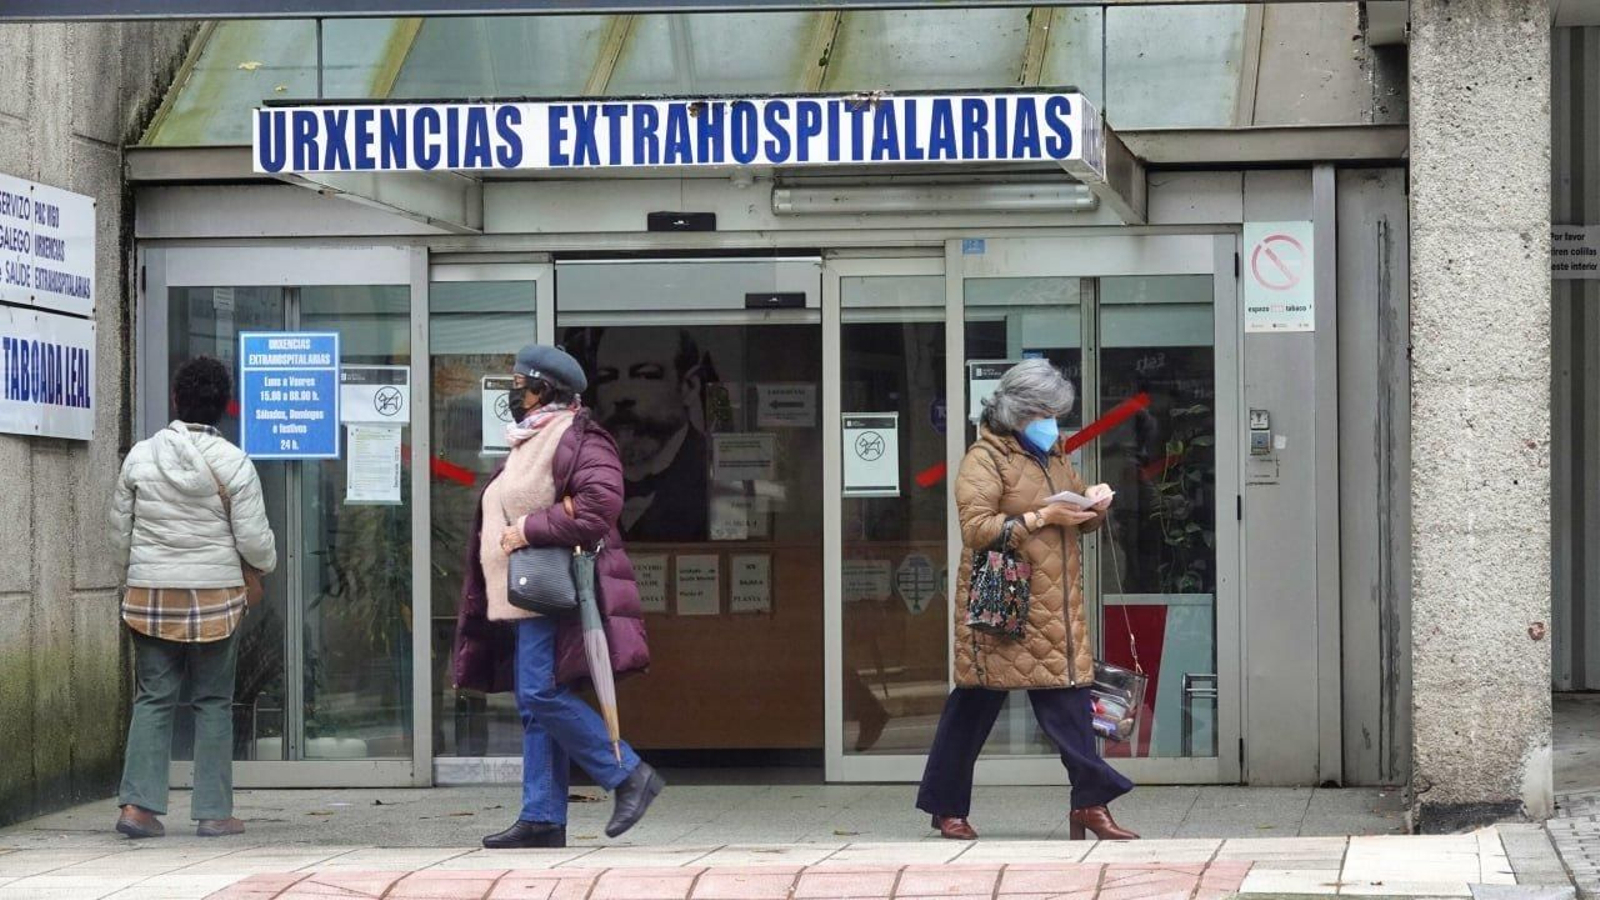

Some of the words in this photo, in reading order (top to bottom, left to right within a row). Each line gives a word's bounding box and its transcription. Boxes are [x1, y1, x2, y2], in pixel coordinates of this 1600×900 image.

[259, 105, 523, 173] URXENCIAS
[548, 96, 1073, 166] EXTRAHOSPITALARIAS
[0, 190, 30, 221] ERVIZO
[35, 201, 46, 226] PAC
[1564, 232, 1585, 241] favor
[35, 234, 65, 262] URXENCIAS
[1570, 247, 1597, 256] colillas
[5, 255, 31, 288] SAÚDE
[1571, 261, 1598, 271] interior
[268, 338, 311, 351] URXENCIAS
[249, 353, 331, 366] EXTRAHOSPITALARIAS
[3, 336, 63, 406] TABOADA
[65, 346, 91, 409] LEAL
[289, 376, 315, 387] Venres
[289, 409, 324, 420] Domingos
[279, 423, 307, 434] festivos
[280, 439, 291, 451] 24
